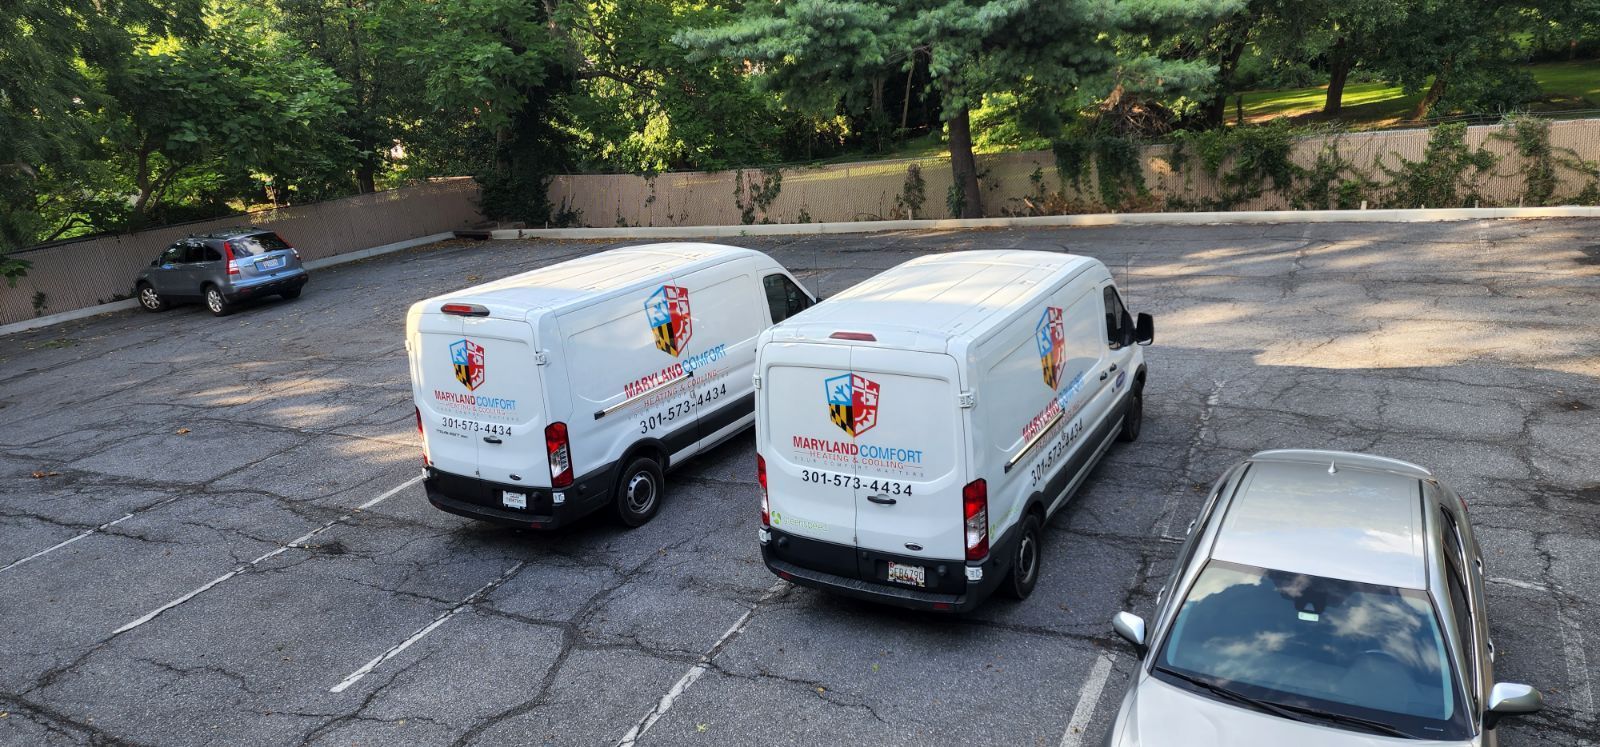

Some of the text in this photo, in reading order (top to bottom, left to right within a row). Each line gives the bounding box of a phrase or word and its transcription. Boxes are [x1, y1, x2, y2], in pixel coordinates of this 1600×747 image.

[623, 363, 683, 400] MARYLAND
[682, 344, 727, 373] COMFORT
[434, 389, 516, 410] MARYLAND COMFORT
[640, 383, 727, 435] 301-573-4434
[644, 388, 678, 408] HEATING
[442, 416, 512, 437] 301-573-4434
[793, 435, 923, 463] MARYLAND COMFORT
[810, 450, 905, 470] HEATING & COOLING
[802, 469, 913, 497] 301-573-4434
